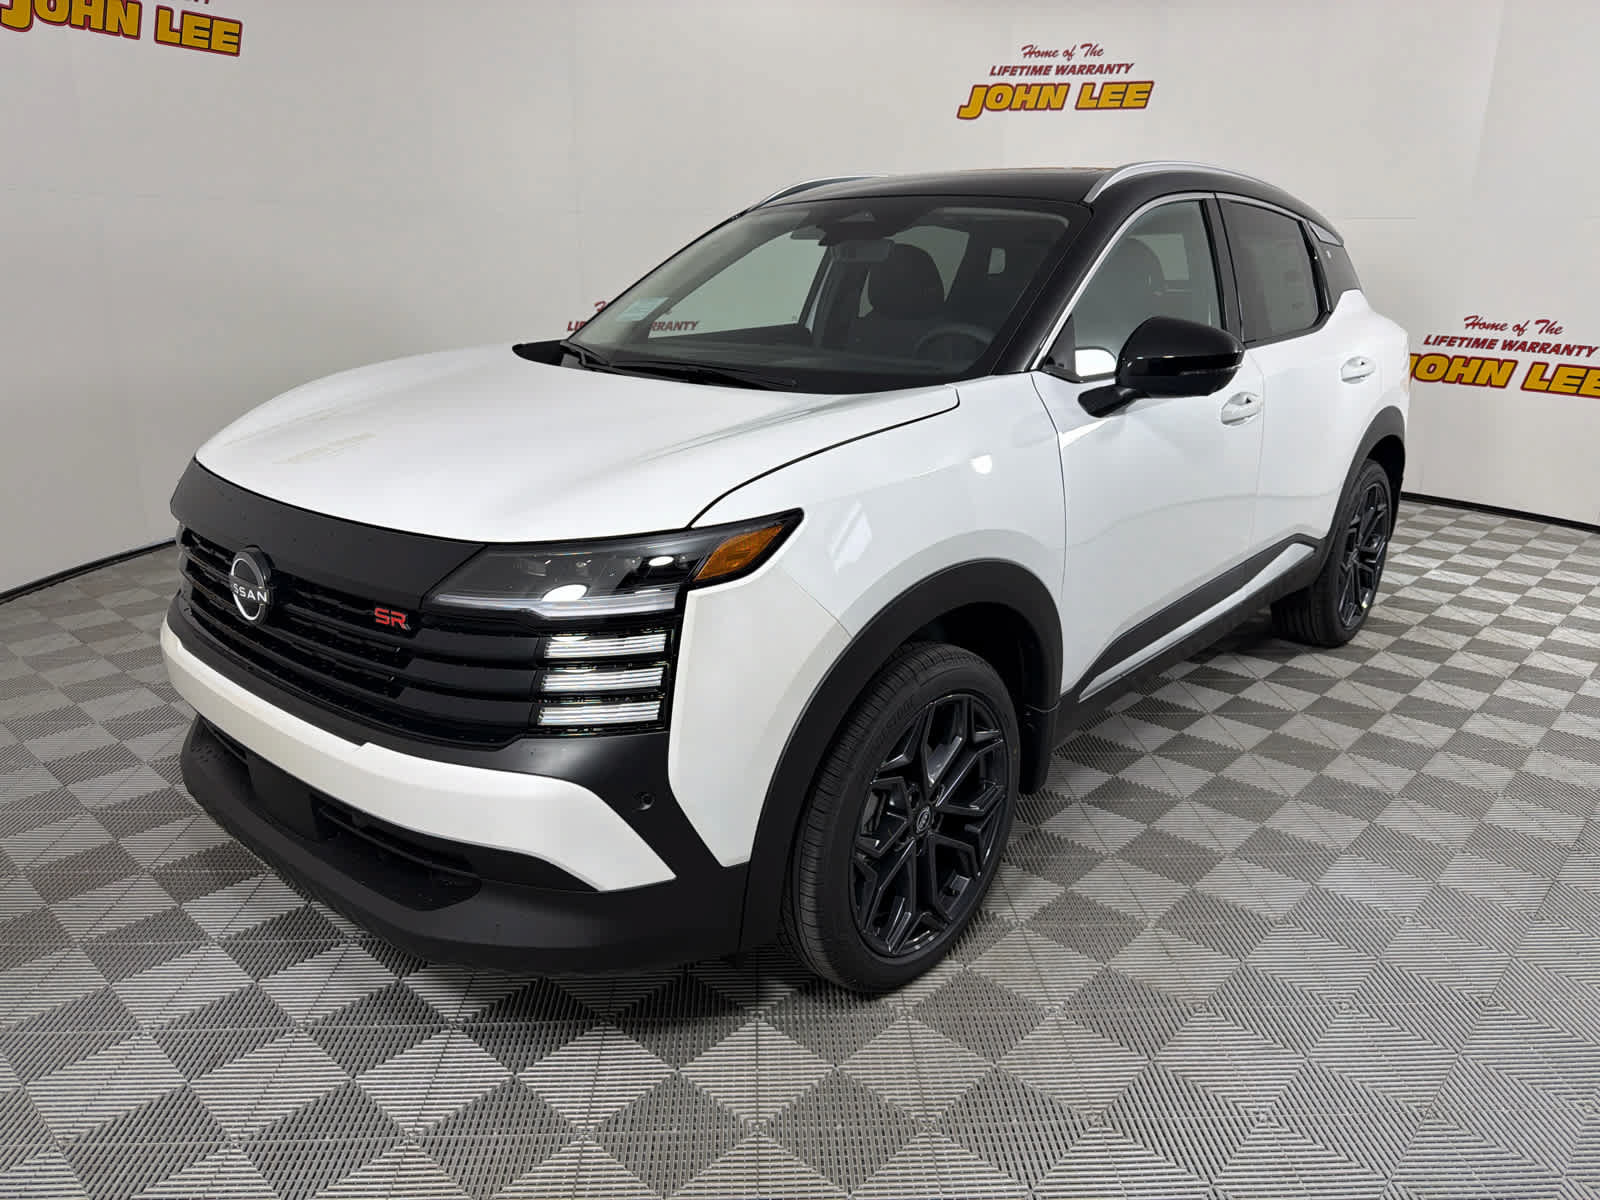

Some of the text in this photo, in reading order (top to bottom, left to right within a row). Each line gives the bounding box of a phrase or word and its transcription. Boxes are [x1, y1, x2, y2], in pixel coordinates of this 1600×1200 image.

[0, 0, 243, 57] JOHN LEE
[1021, 43, 1105, 60] Home of The
[989, 62, 1135, 77] LIFETIME WARRANTY
[956, 80, 1155, 120] JOHN LEE
[649, 320, 700, 332] RRANTY
[1463, 315, 1565, 337] Home of The
[1423, 334, 1599, 358] LIFETIME WARRANTY
[230, 582, 268, 602] SSAN
[374, 607, 410, 630] SR
